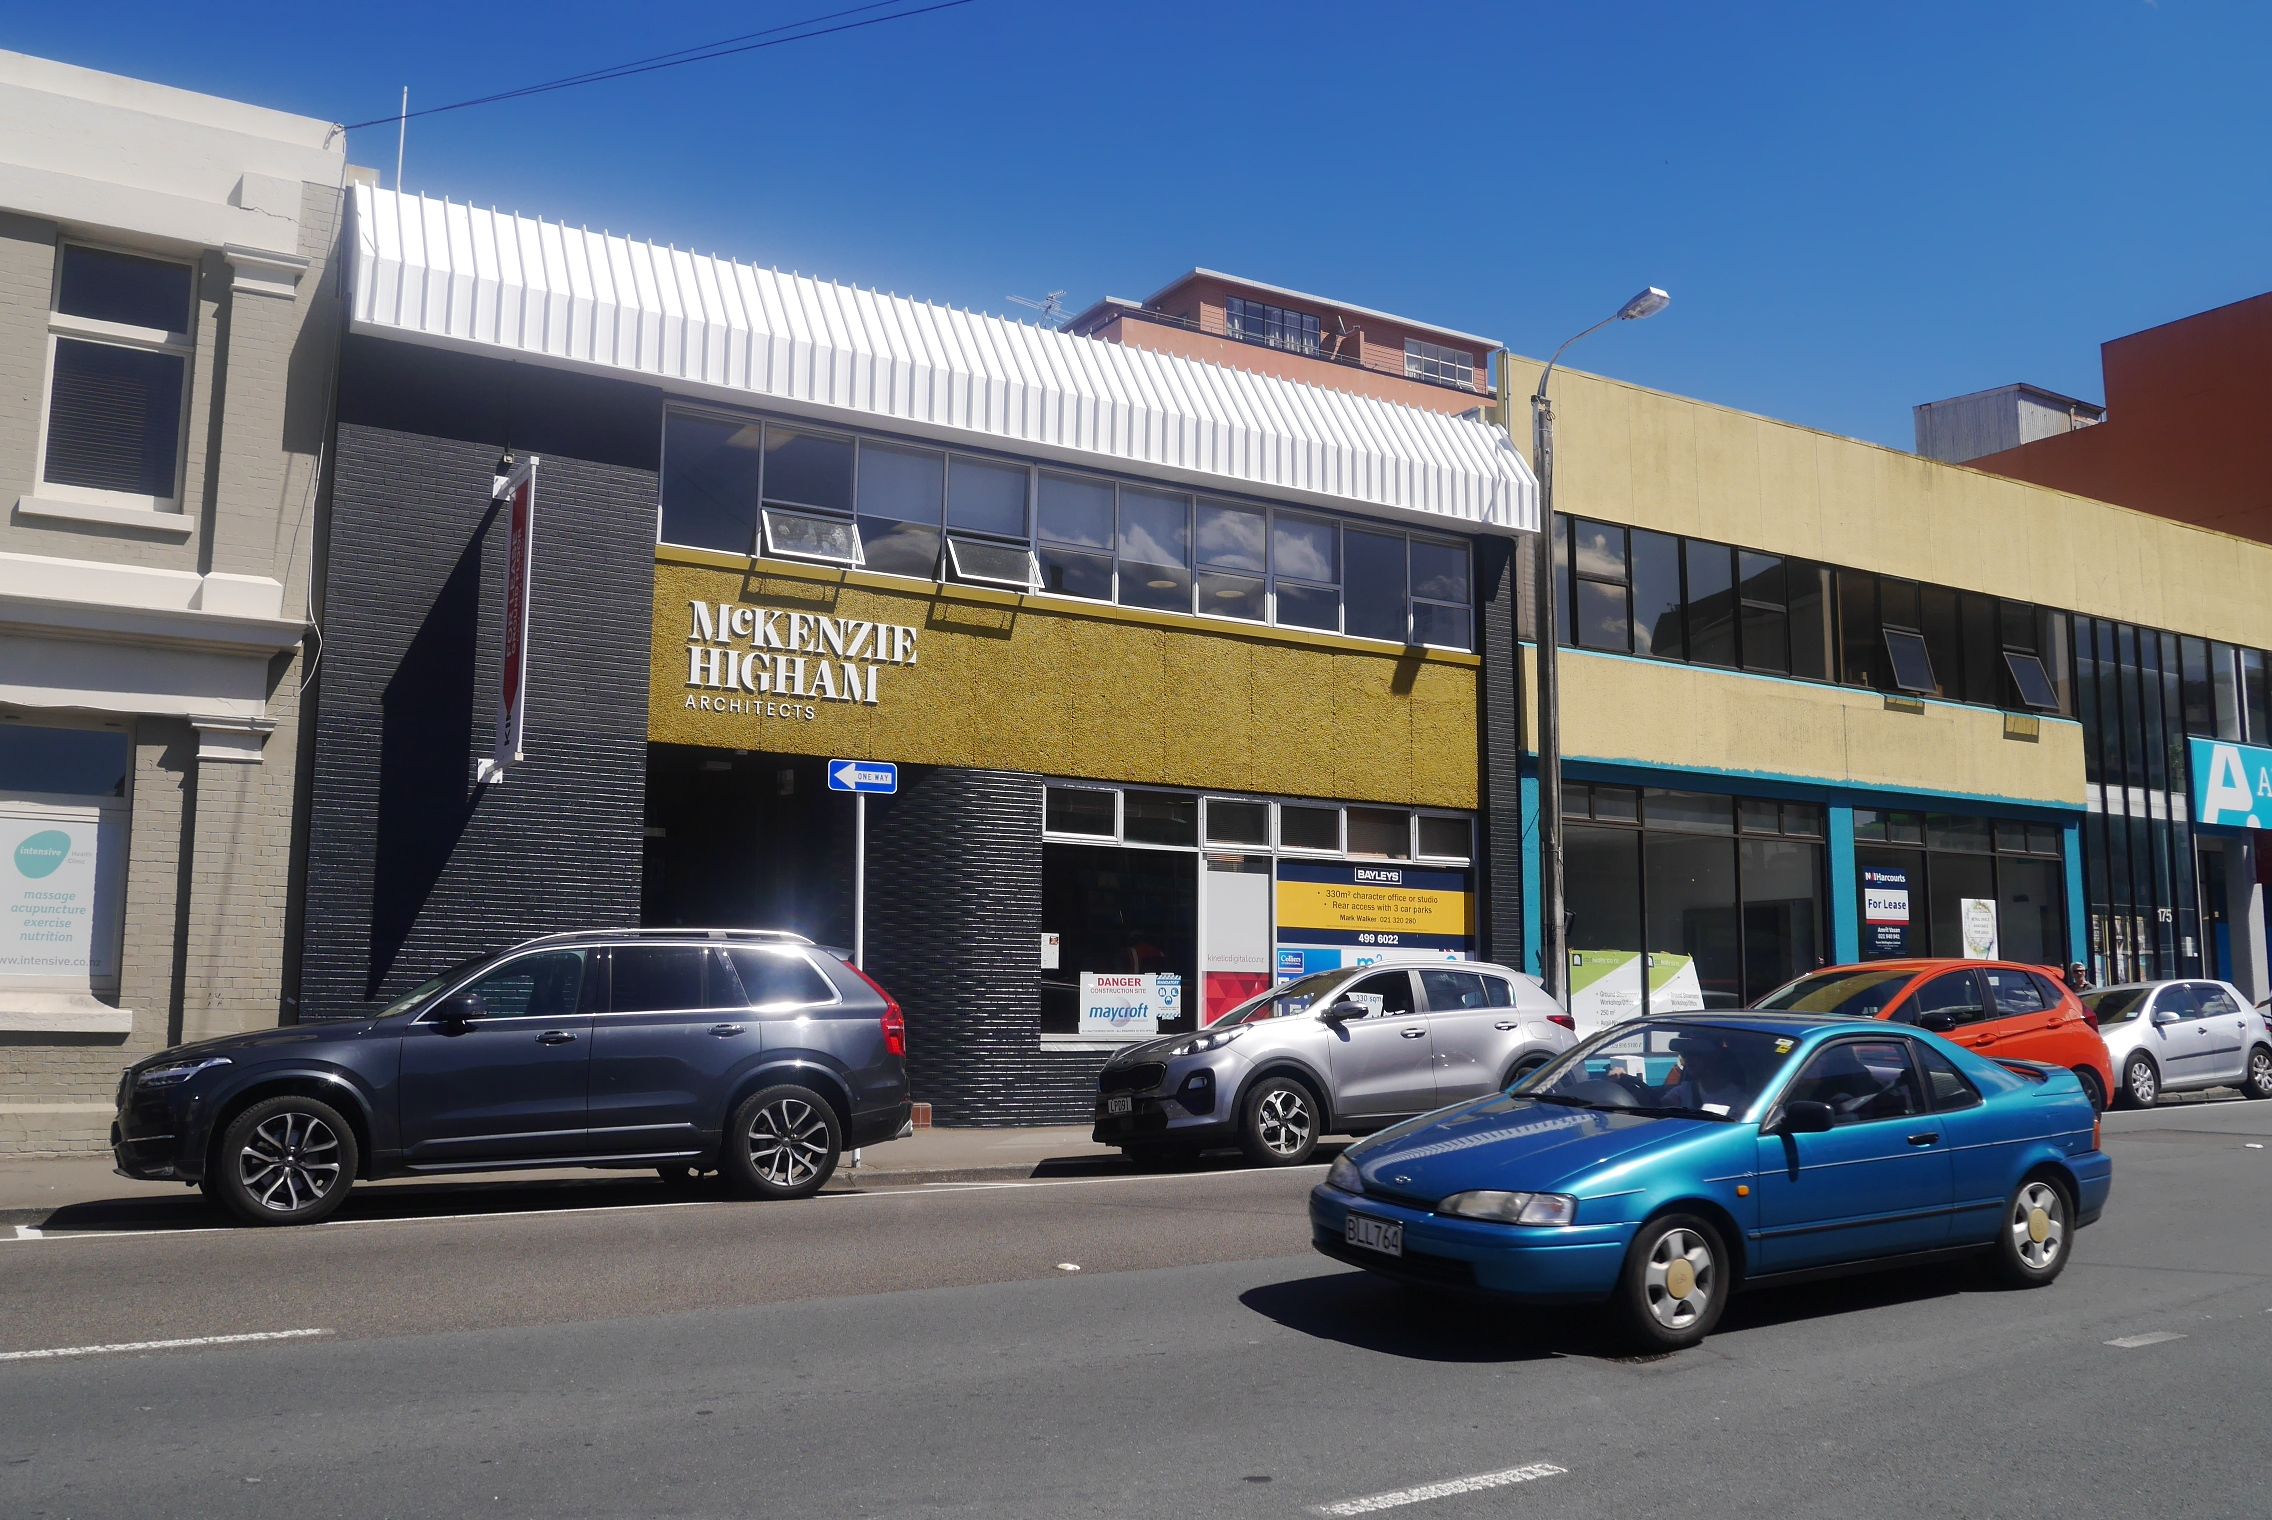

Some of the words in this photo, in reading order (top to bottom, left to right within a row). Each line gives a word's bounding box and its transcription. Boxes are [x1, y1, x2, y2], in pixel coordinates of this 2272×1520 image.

[688, 600, 917, 664] McKENZIE
[685, 645, 880, 704] HIGHAM
[685, 694, 815, 720] ARCHITECTS
[857, 772, 872, 781] ONE
[875, 774, 889, 782] WAY
[20, 846, 62, 857] intensive
[1357, 869, 1399, 882] BAYLEYS
[1877, 873, 1906, 883] Harcourts
[24, 890, 76, 903] massage
[1352, 891, 1386, 901] character
[1387, 893, 1406, 902] office
[10, 903, 87, 915] acupuncture
[1332, 901, 1349, 909] Rear
[1351, 903, 1375, 911] access
[1377, 903, 1392, 911] with
[1393, 904, 1399, 912] 3
[1413, 906, 1432, 914] parks
[1868, 898, 1881, 908] For
[1883, 900, 1907, 910] Lease
[1340, 914, 1355, 922] Mark
[1357, 915, 1377, 923] Walker
[2157, 908, 2173, 923] 175
[23, 917, 72, 928] exercise
[20, 930, 73, 942] nutrition
[1358, 933, 1375, 943] 499
[1377, 934, 1399, 944] 6022
[1097, 977, 1141, 987] DANGER
[1089, 1002, 1149, 1021] maycroft
[1347, 1218, 1399, 1250] BLL764
